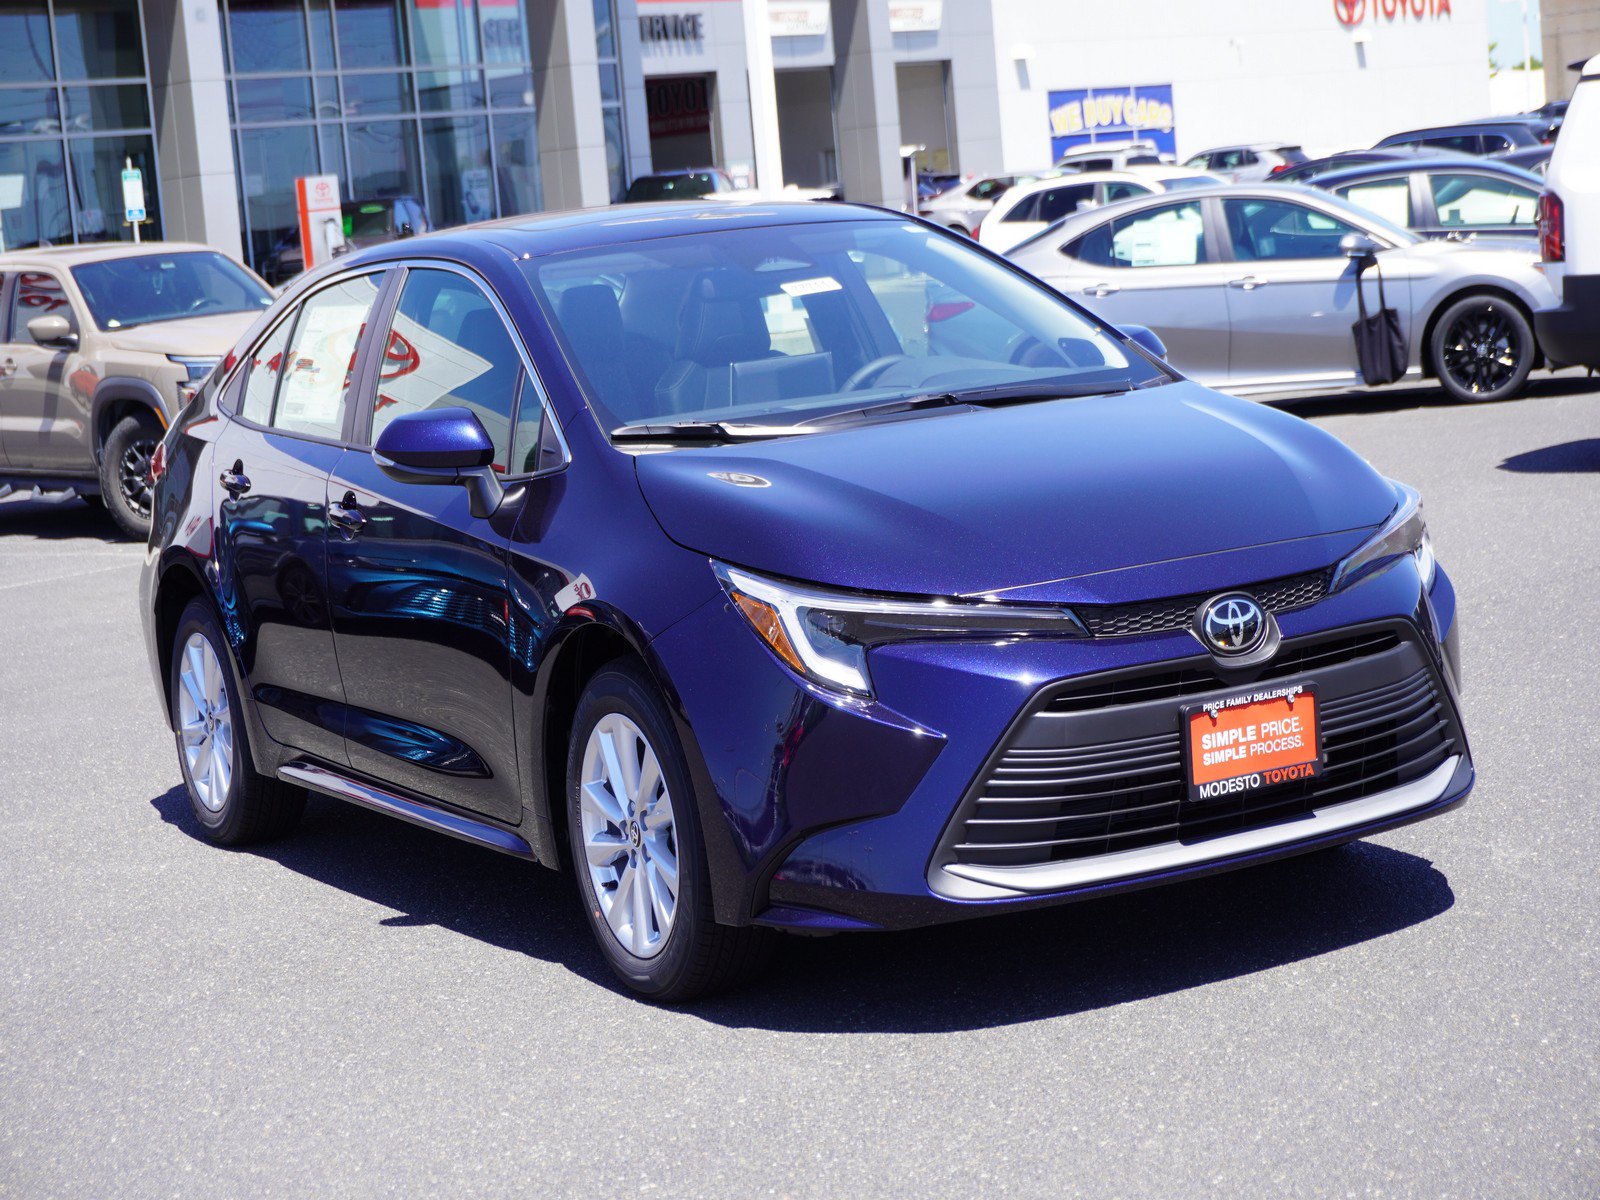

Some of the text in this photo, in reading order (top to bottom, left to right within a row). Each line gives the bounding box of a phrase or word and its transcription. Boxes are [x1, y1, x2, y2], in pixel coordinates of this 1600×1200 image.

[1050, 95, 1173, 137] WE BUY CARS
[1203, 685, 1303, 712] PRICE FAMILY DEALERSHIPS
[1202, 716, 1303, 750] SIMPLE PRICE.
[1203, 735, 1305, 766] SIMPLE PROCESS.
[1199, 763, 1315, 799] MODESTO TOYOTA
